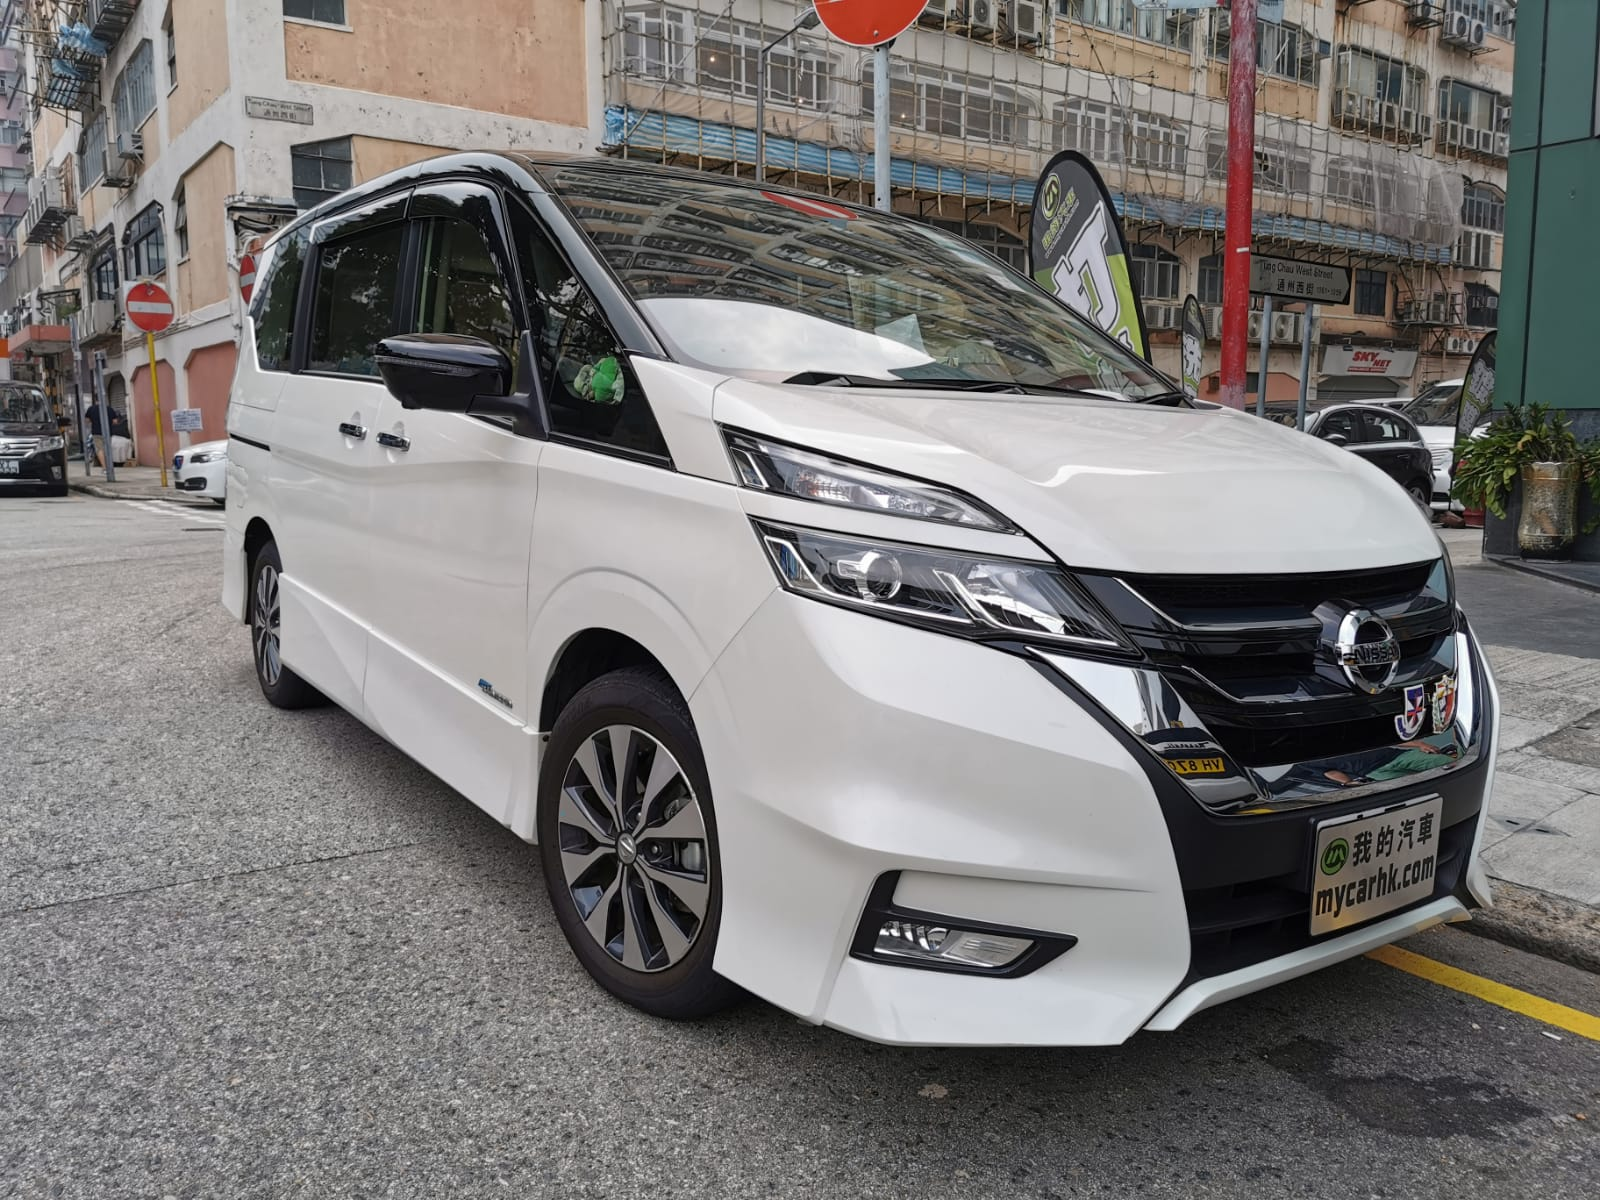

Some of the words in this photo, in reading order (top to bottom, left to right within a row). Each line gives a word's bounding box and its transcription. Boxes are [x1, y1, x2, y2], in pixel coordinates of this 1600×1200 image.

[1051, 199, 1134, 351] 打
[1296, 264, 1313, 277] West
[1313, 268, 1334, 280] Street
[1277, 278, 1315, 296] 通州西街
[1352, 351, 1380, 362] SKY
[1372, 359, 1393, 368] NET
[1352, 812, 1435, 867] 我的汽車
[1315, 855, 1435, 918] mycarhk.com
